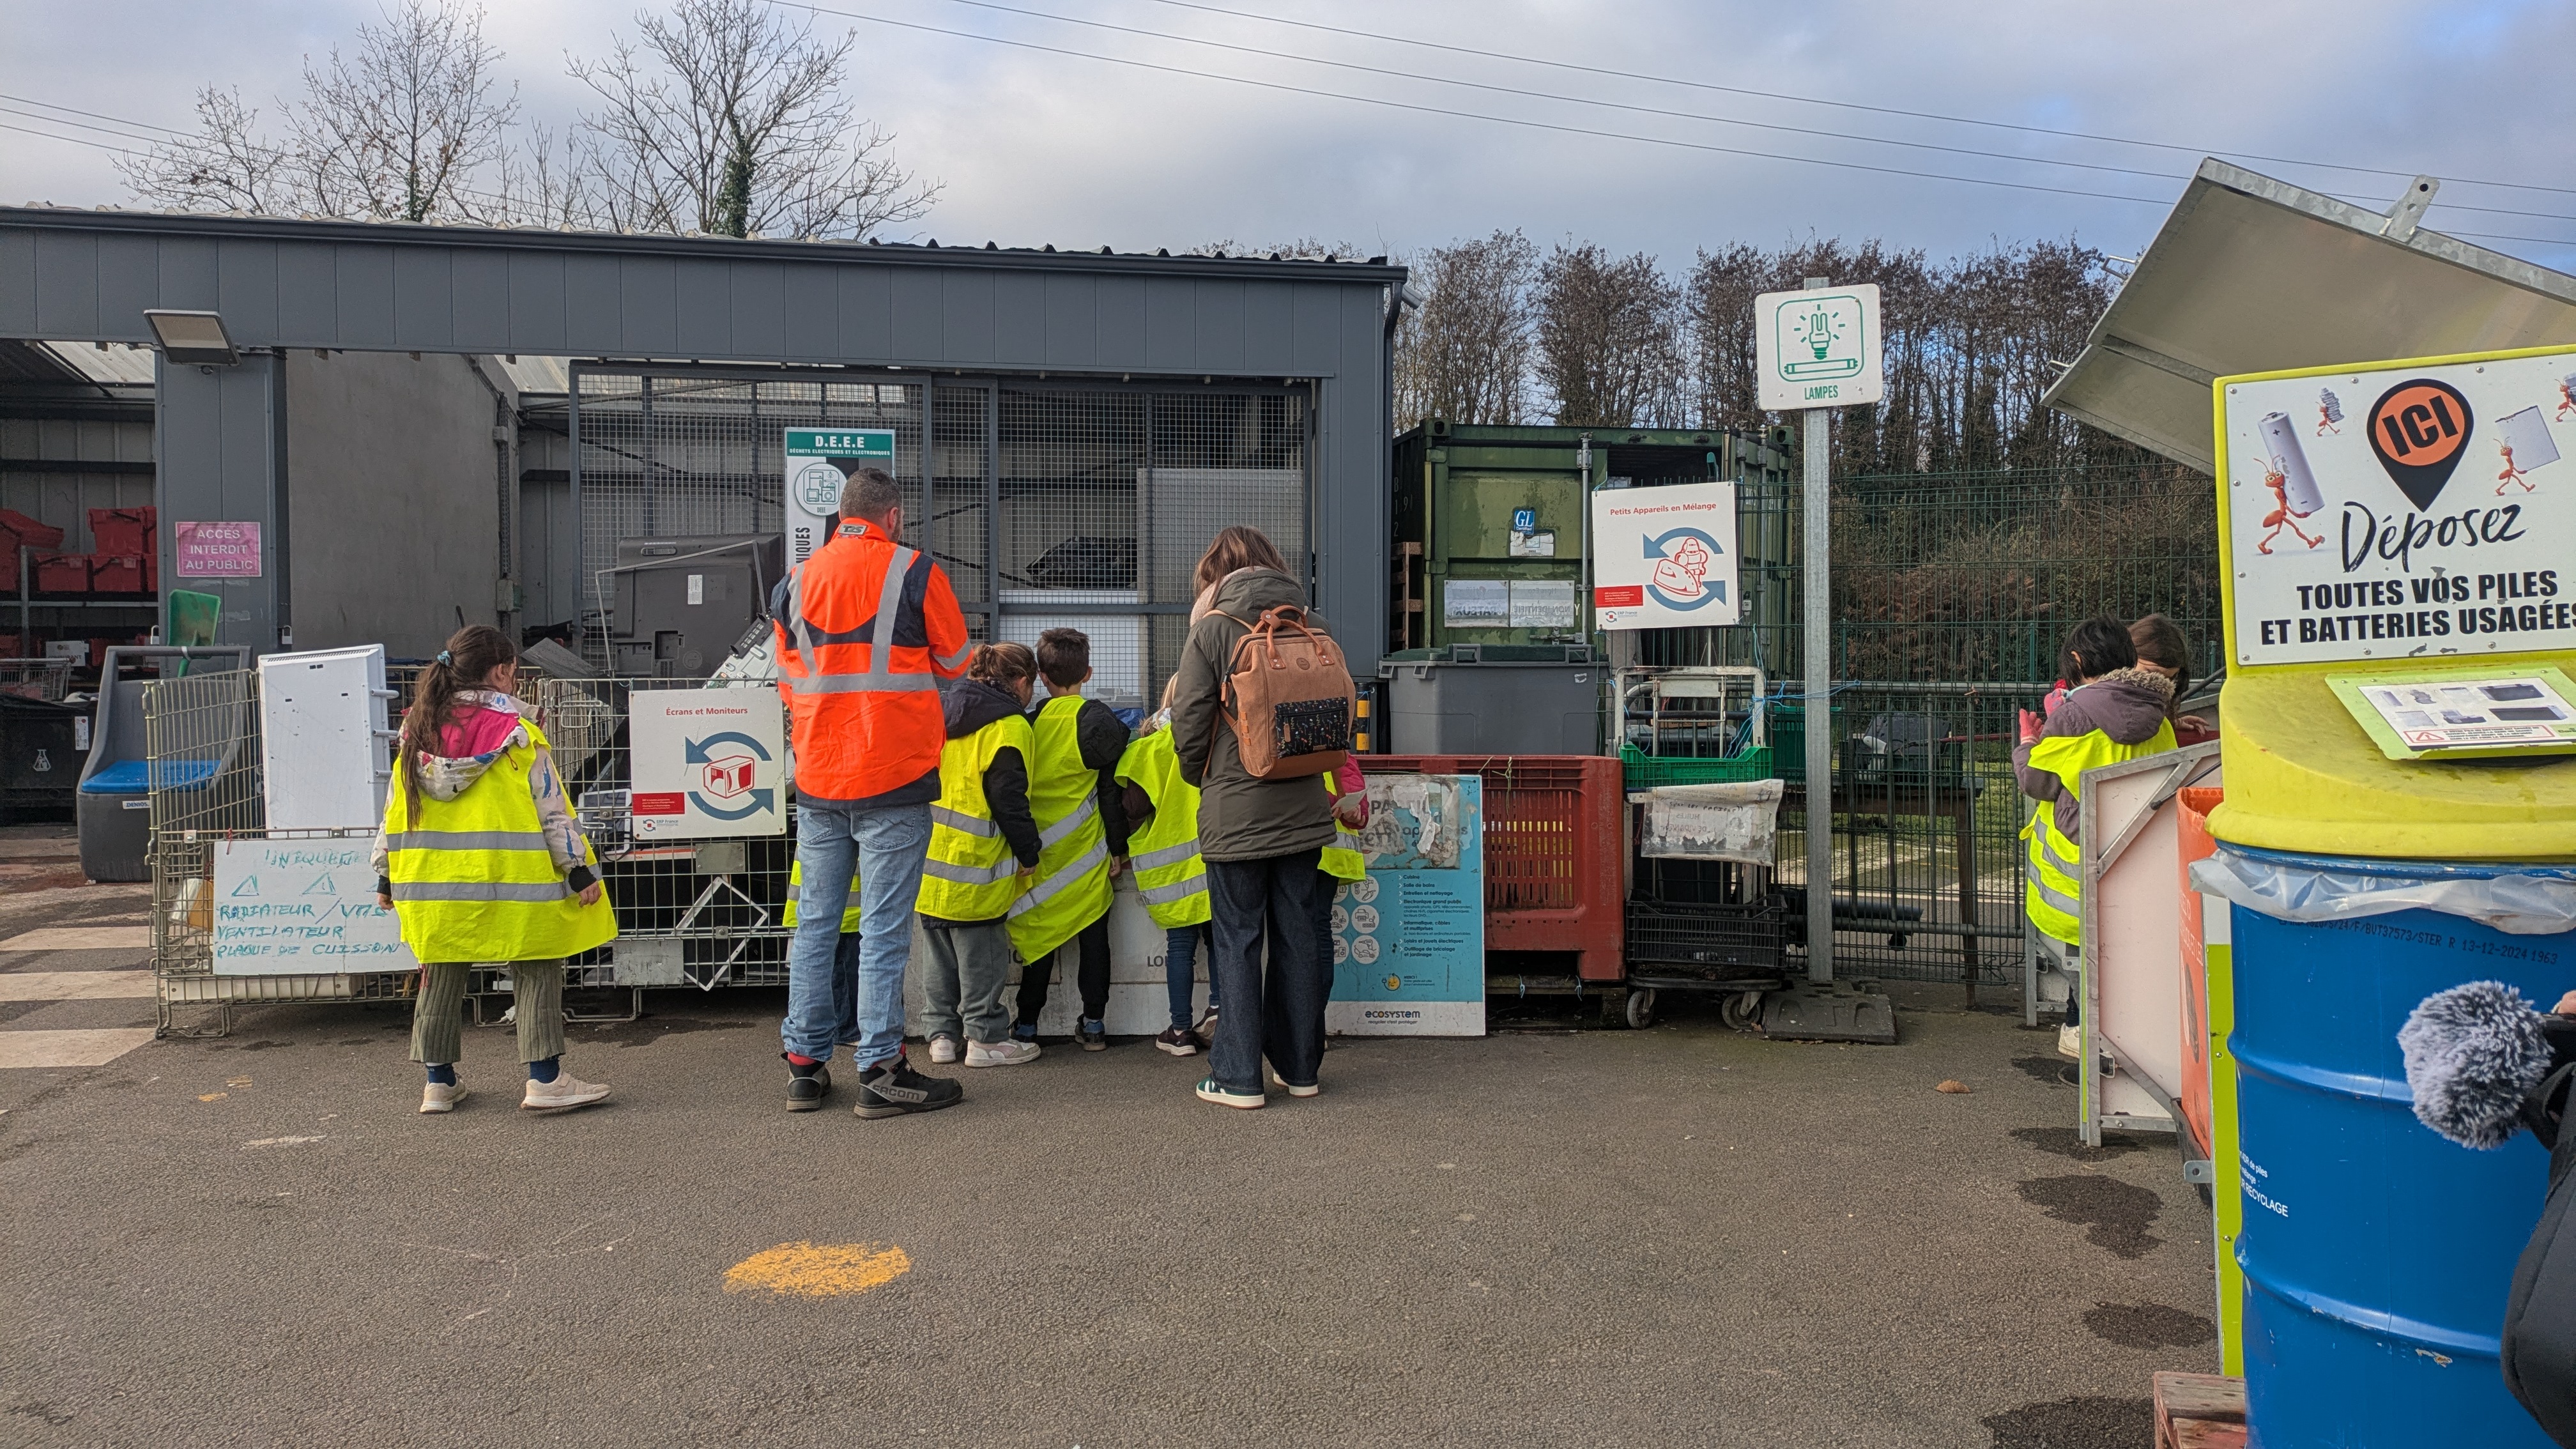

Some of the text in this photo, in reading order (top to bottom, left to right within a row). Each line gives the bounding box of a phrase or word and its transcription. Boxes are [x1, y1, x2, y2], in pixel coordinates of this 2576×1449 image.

[1804, 385, 1839, 400] LAMPES
[2382, 395, 2458, 457] ICI
[815, 435, 864, 448] D.E.E.E
[1633, 505, 1669, 515] Appareils
[1683, 502, 1717, 511] Mélange
[1515, 510, 1534, 527] GL
[197, 528, 240, 539] ACCÈS
[2342, 502, 2530, 573] Déposez
[190, 545, 247, 555] INTERDIT
[186, 560, 253, 570] AU PUBLIC
[2297, 570, 2558, 611] TOUTES VOS PILES
[2261, 619, 2292, 645] ET
[2299, 610, 2451, 643] BATTERIES
[666, 707, 693, 716] Écrans
[220, 903, 315, 921] RADIATEUR
[218, 926, 344, 940] VENTILATEUR
[217, 944, 272, 958] PLAQUE
[2448, 937, 2456, 949] R
[2462, 940, 2527, 960] 13-12-2024
[2531, 949, 2557, 965] 1963
[2246, 1182, 2288, 1218] RECYCLAGE
